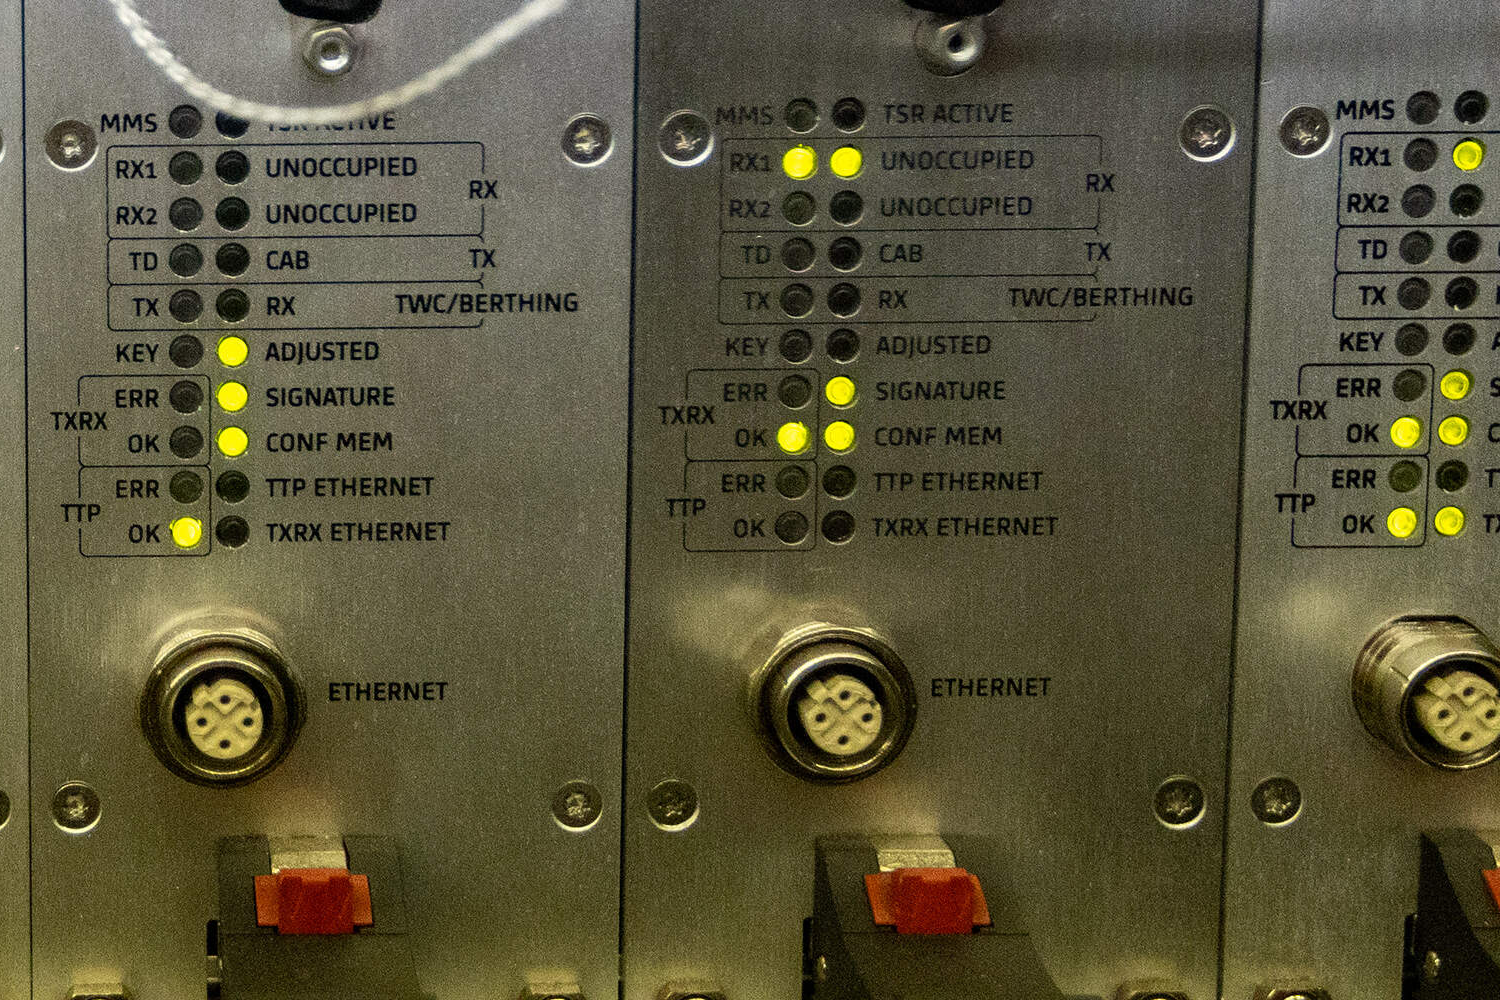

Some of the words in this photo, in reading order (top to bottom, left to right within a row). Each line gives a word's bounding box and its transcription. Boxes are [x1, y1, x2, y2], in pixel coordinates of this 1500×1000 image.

[715, 106, 775, 126] MMS
[884, 104, 926, 125] TSR
[933, 103, 1013, 124] ACTIVE
[1336, 99, 1395, 120] MMS
[100, 114, 158, 133] MMS
[730, 153, 770, 172] RX1
[881, 150, 1034, 171] UNOCCUPIED
[1349, 146, 1392, 167] RX1
[116, 160, 156, 179] RX1
[266, 157, 417, 178] UNOCCUPIED
[469, 180, 499, 200] RX
[1085, 173, 1116, 193] RX
[729, 200, 771, 219] RX2
[880, 196, 1032, 217] UNOCCUPIED
[1347, 193, 1390, 213] RX2
[116, 206, 158, 226] RX2
[266, 203, 417, 224] UNOCCUPIED
[469, 248, 497, 268] TX
[741, 245, 771, 265] TD
[879, 243, 923, 263] CAB
[1084, 242, 1112, 262] TX
[1357, 239, 1388, 260] TD
[129, 252, 158, 271] TD
[266, 250, 309, 270] CAB
[395, 293, 578, 315] TWC/BERTHING
[743, 291, 771, 310] TX
[879, 290, 909, 310] RX
[1008, 286, 1194, 308] TWC/BERTHING
[1358, 285, 1387, 306] TX
[132, 298, 160, 317] TX
[266, 296, 296, 316] RX
[725, 337, 769, 357] KEY
[875, 335, 991, 359] ADJUSTED
[1339, 331, 1385, 352] KEY
[116, 343, 160, 363] KEY
[266, 341, 380, 366] ADJUSTED
[266, 387, 395, 407] SIGNATURE
[723, 382, 768, 403] ERR
[875, 380, 1006, 402] SIGNATURE
[1336, 377, 1381, 398] ERR
[115, 389, 159, 408] ERR
[659, 405, 716, 426] TXRX
[1269, 400, 1328, 420] TXRX
[50, 411, 108, 431] TXRX
[266, 432, 328, 453] CONF
[336, 432, 393, 452] MEM
[734, 428, 768, 448] OK
[875, 427, 937, 447] CONF
[945, 425, 1002, 446] MEM
[1346, 423, 1380, 444] OK
[128, 434, 160, 454] OK
[116, 479, 160, 499] ERR
[266, 477, 306, 498] TTP
[314, 477, 434, 497] ETHERNET
[722, 474, 766, 494] ERR
[873, 472, 914, 492] TTP
[921, 471, 1044, 492] ETHERNET
[1331, 469, 1376, 489] ERR
[61, 503, 101, 523] TTP
[665, 498, 707, 518] TTP
[1274, 493, 1316, 514] TTP
[128, 524, 160, 544] OK
[266, 522, 322, 542] TXRX
[330, 522, 450, 542] ETHERNET
[733, 519, 767, 538] OK
[872, 517, 929, 538] TXRX
[937, 516, 1058, 537] ETHERNET
[1342, 514, 1375, 534] OK
[328, 681, 448, 702] ETHERNET
[931, 677, 1052, 698] ETHERNET
